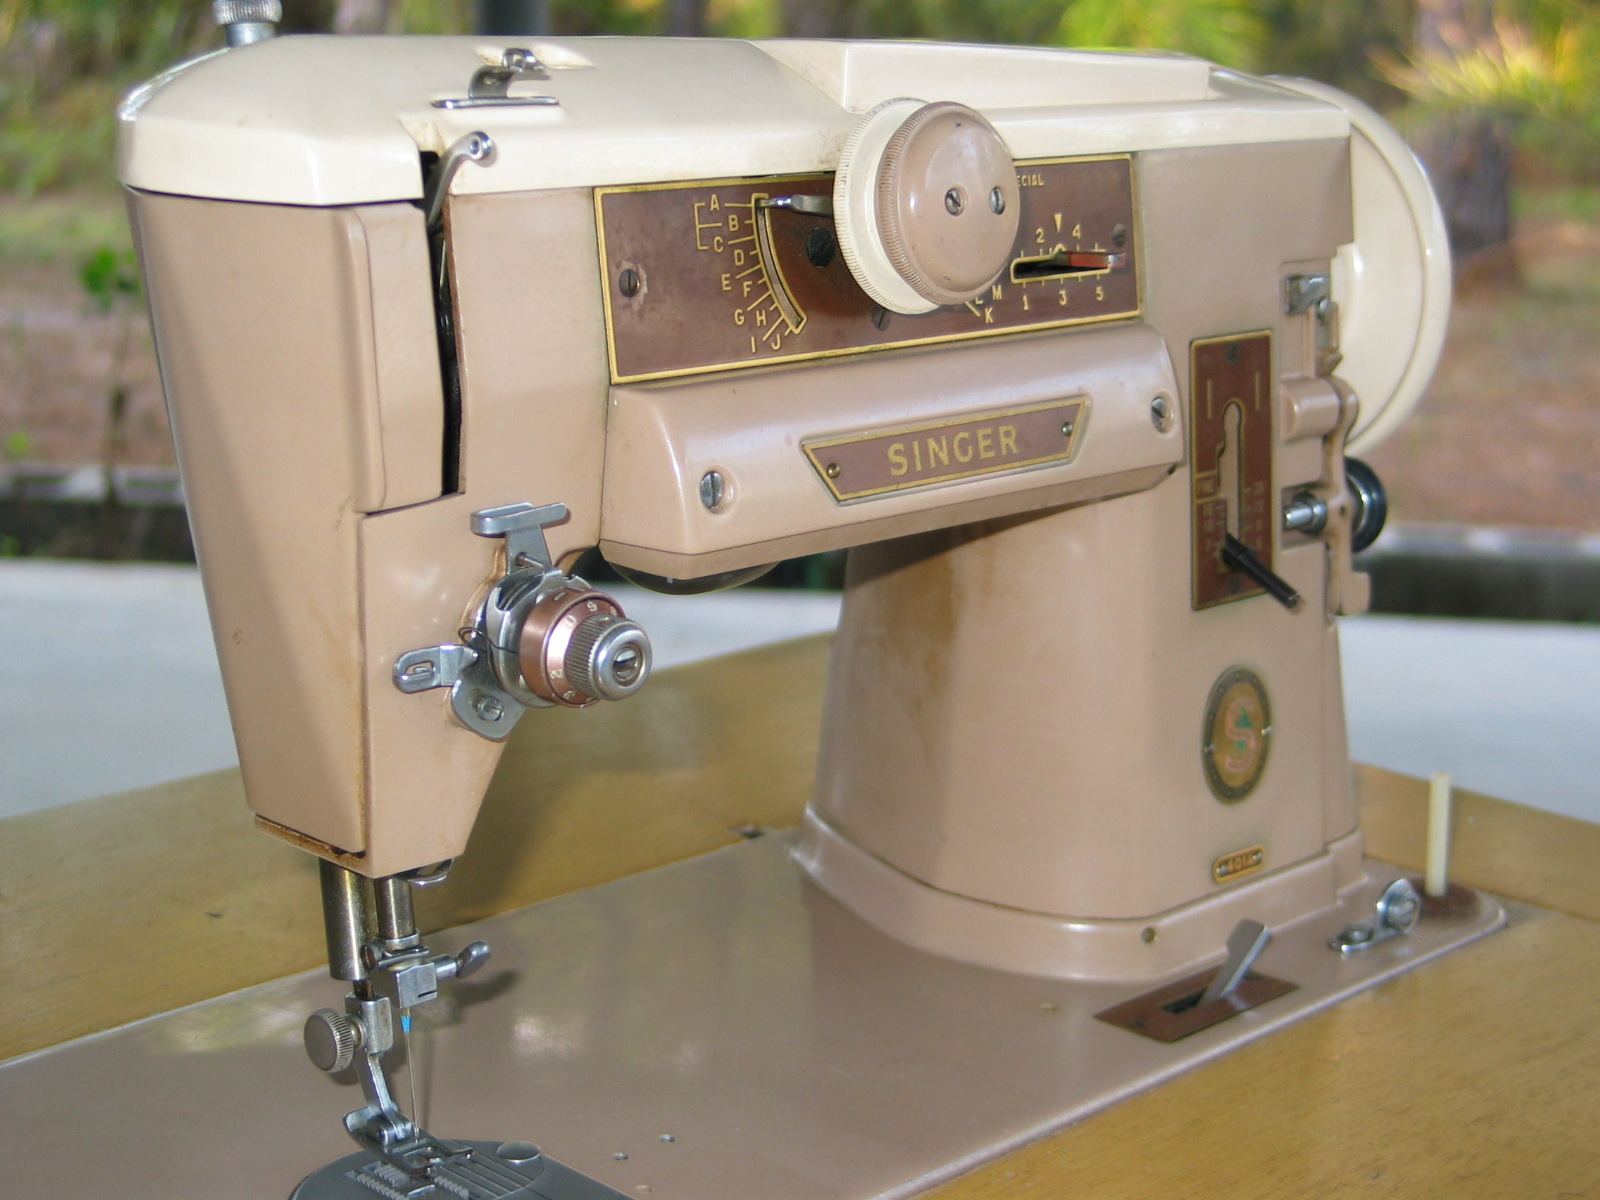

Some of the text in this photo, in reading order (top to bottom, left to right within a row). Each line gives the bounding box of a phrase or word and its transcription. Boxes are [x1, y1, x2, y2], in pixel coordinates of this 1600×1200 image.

[1017, 174, 1044, 187] ECIAL
[710, 194, 720, 212] A
[729, 214, 739, 231] B
[1035, 228, 1046, 244] 2
[1072, 224, 1082, 240] 4
[714, 236, 724, 253] C
[734, 249, 745, 266] D
[722, 274, 732, 291] E
[743, 281, 752, 298] F
[992, 284, 1002, 300] M
[1058, 290, 1068, 306] 3
[1096, 286, 1104, 301] 5
[1022, 294, 1030, 310] 1
[734, 310, 745, 326] G
[756, 310, 766, 326] H
[985, 307, 994, 324] K
[750, 336, 756, 353] I
[772, 334, 782, 351] J
[887, 424, 1019, 477] SINGER
[550, 668, 562, 680] 2
